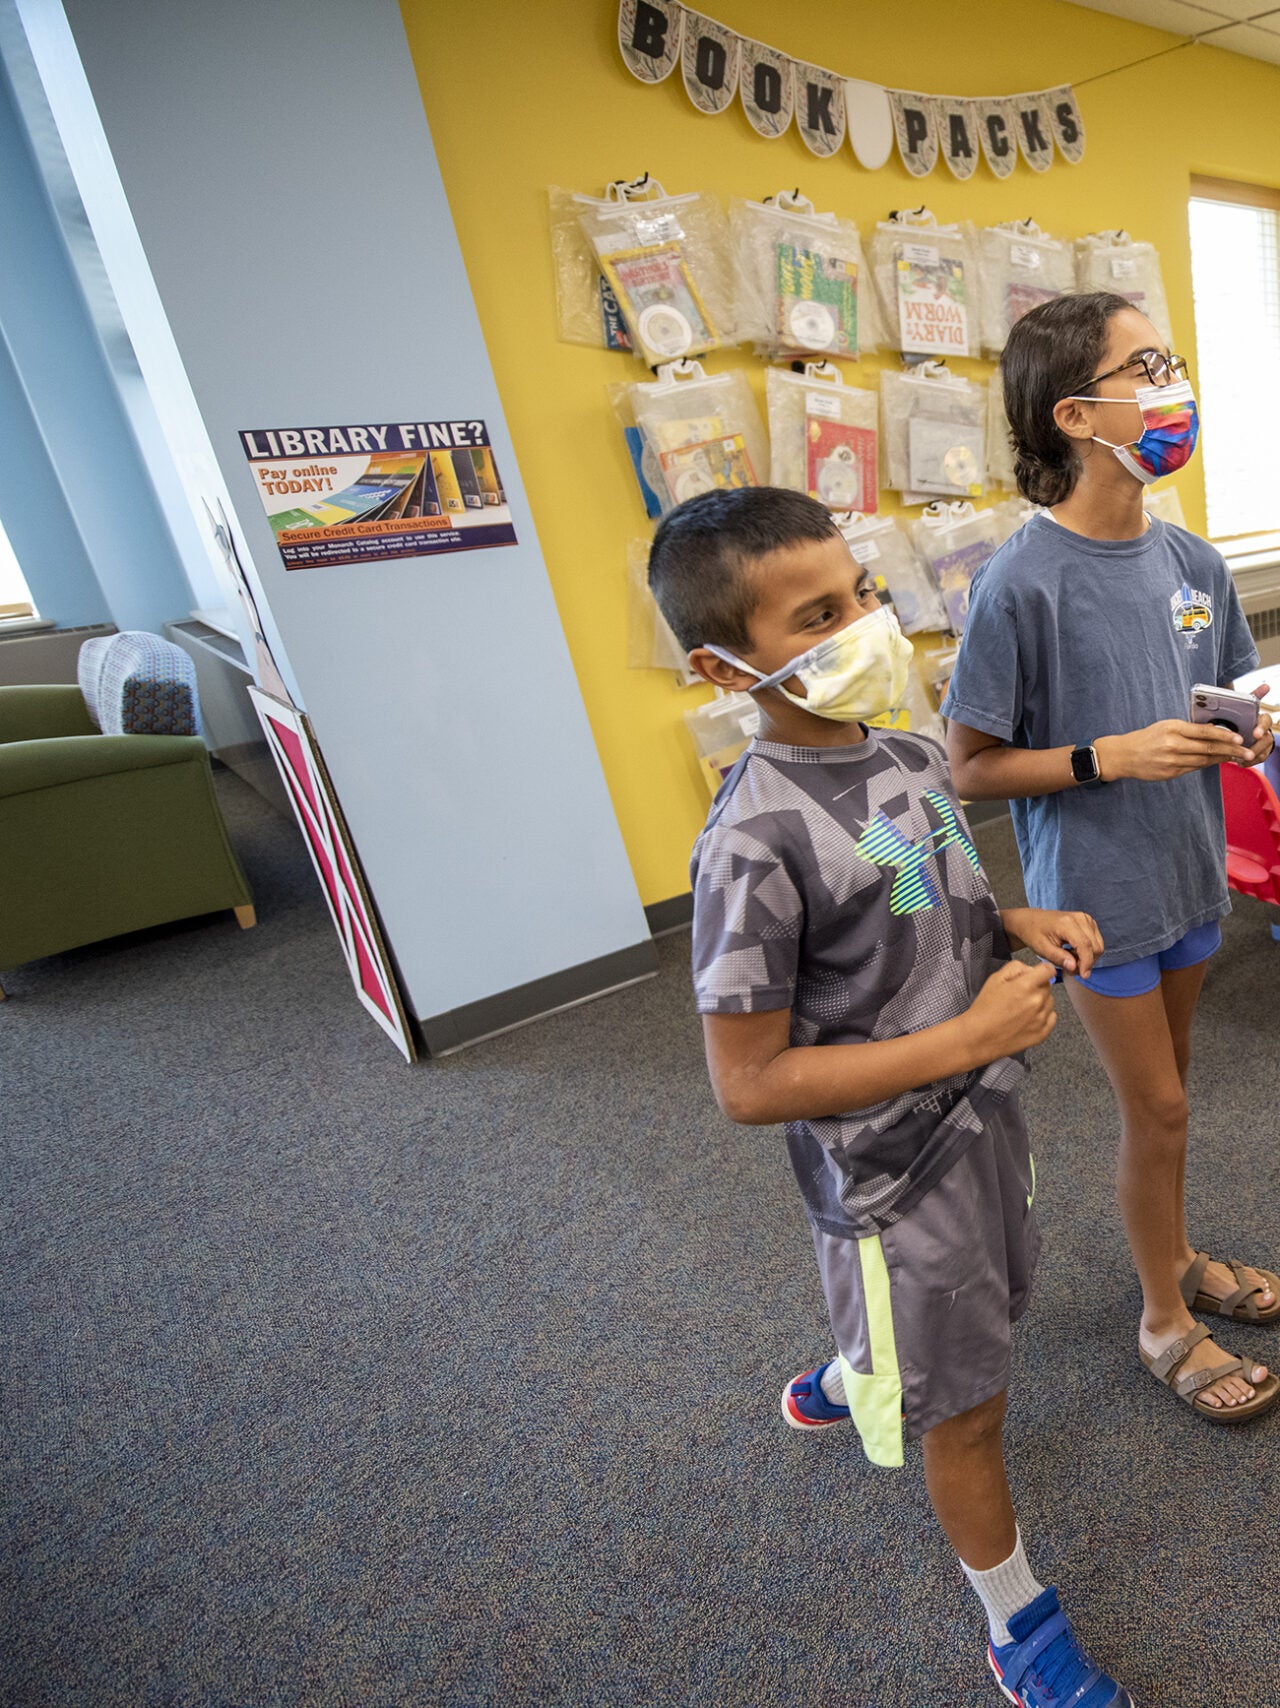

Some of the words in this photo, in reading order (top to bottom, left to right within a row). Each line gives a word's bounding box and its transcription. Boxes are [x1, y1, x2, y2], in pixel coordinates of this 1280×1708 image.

[631, 2, 837, 135] BOOK
[903, 102, 1080, 158] PACKS
[903, 300, 961, 324] WORM
[244, 426, 388, 458] LIBRARY
[399, 422, 484, 448] FINE?
[258, 468, 288, 480] Pay
[292, 464, 338, 476] online
[262, 478, 334, 496] TODAY!
[282, 532, 320, 541] Secure
[324, 527, 355, 537] Credit
[359, 524, 383, 534] Card
[385, 519, 448, 531] Transactions
